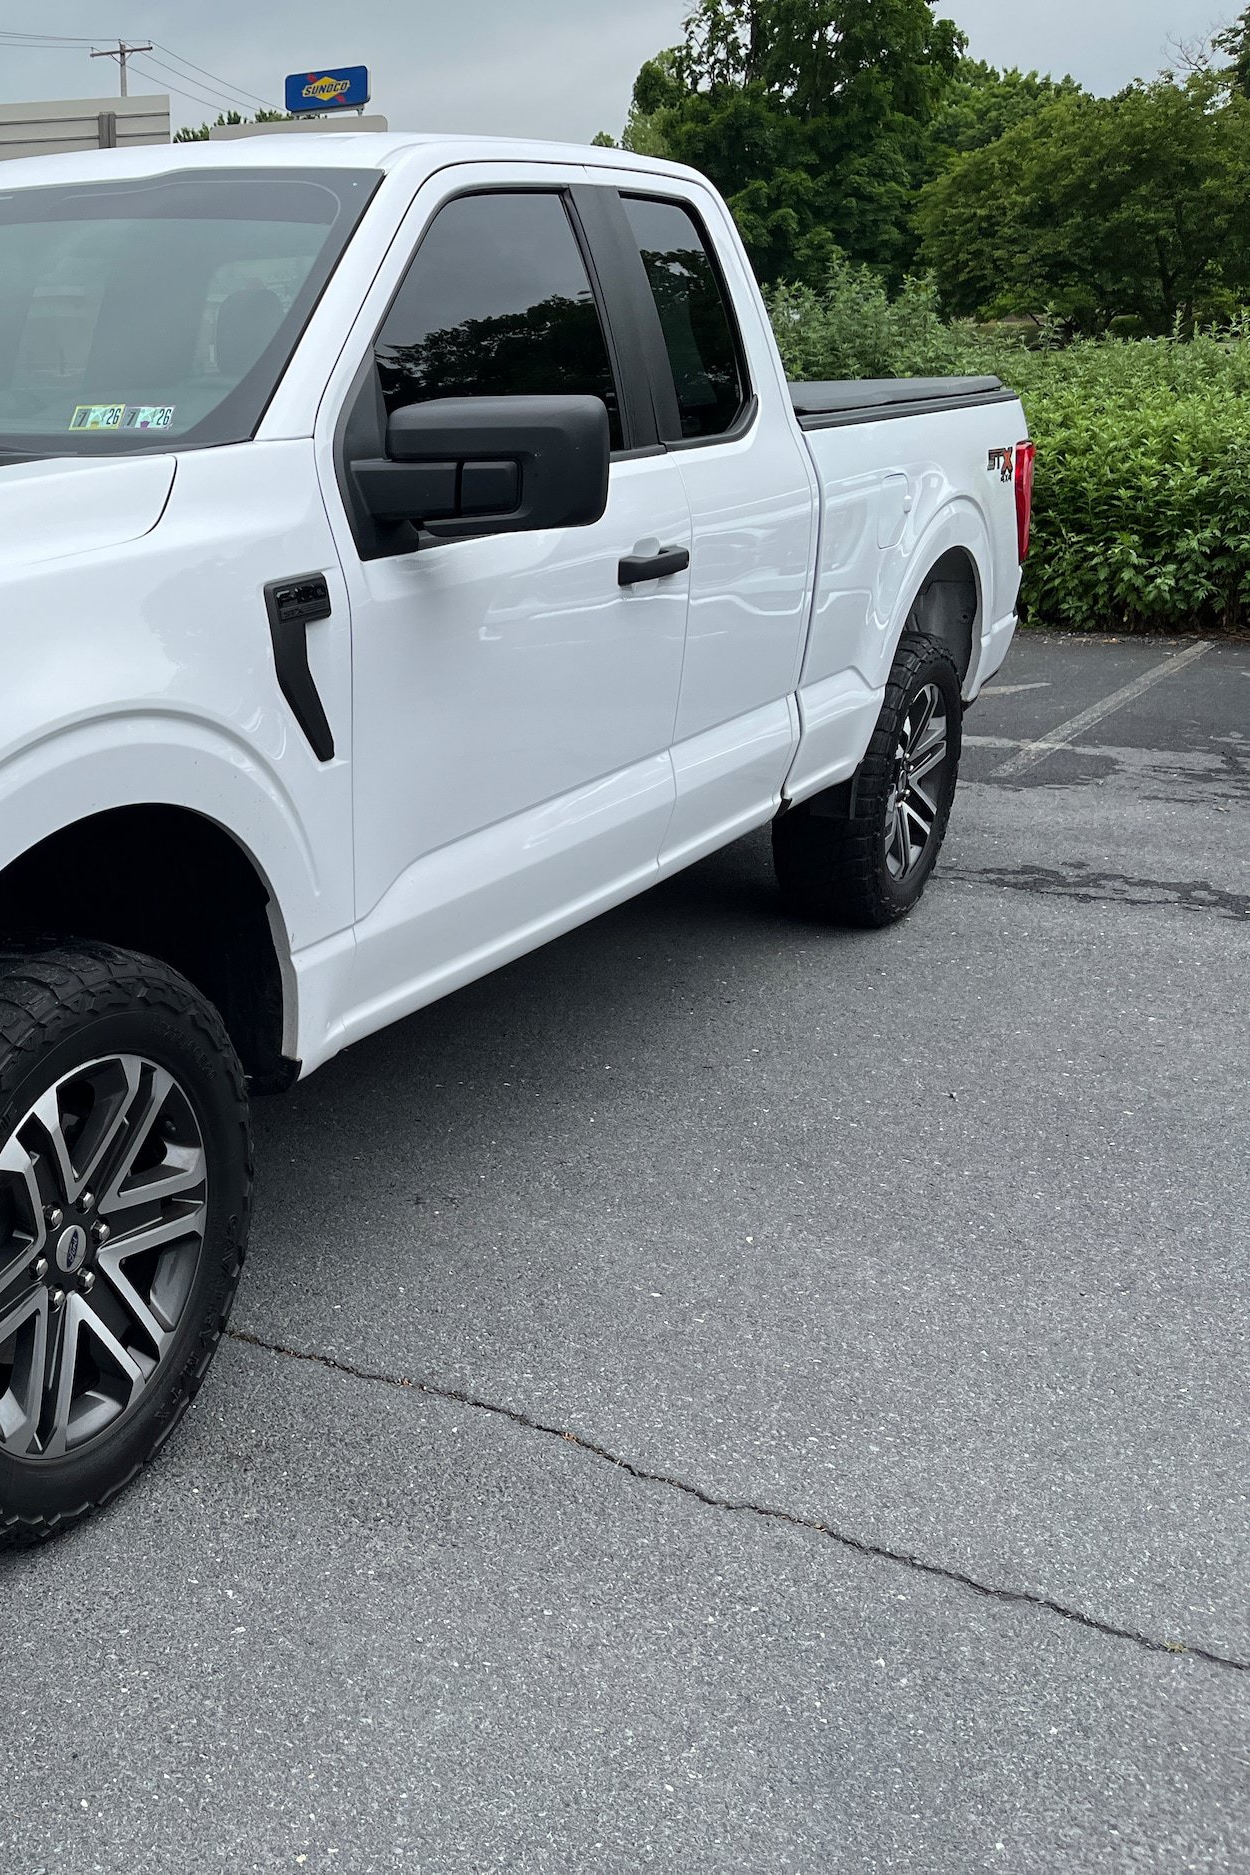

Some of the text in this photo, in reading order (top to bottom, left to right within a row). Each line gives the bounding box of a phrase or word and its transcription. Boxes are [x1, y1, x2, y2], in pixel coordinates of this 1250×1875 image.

[304, 82, 348, 96] SUNOCO
[106, 408, 122, 425] 26
[156, 408, 172, 426] 26
